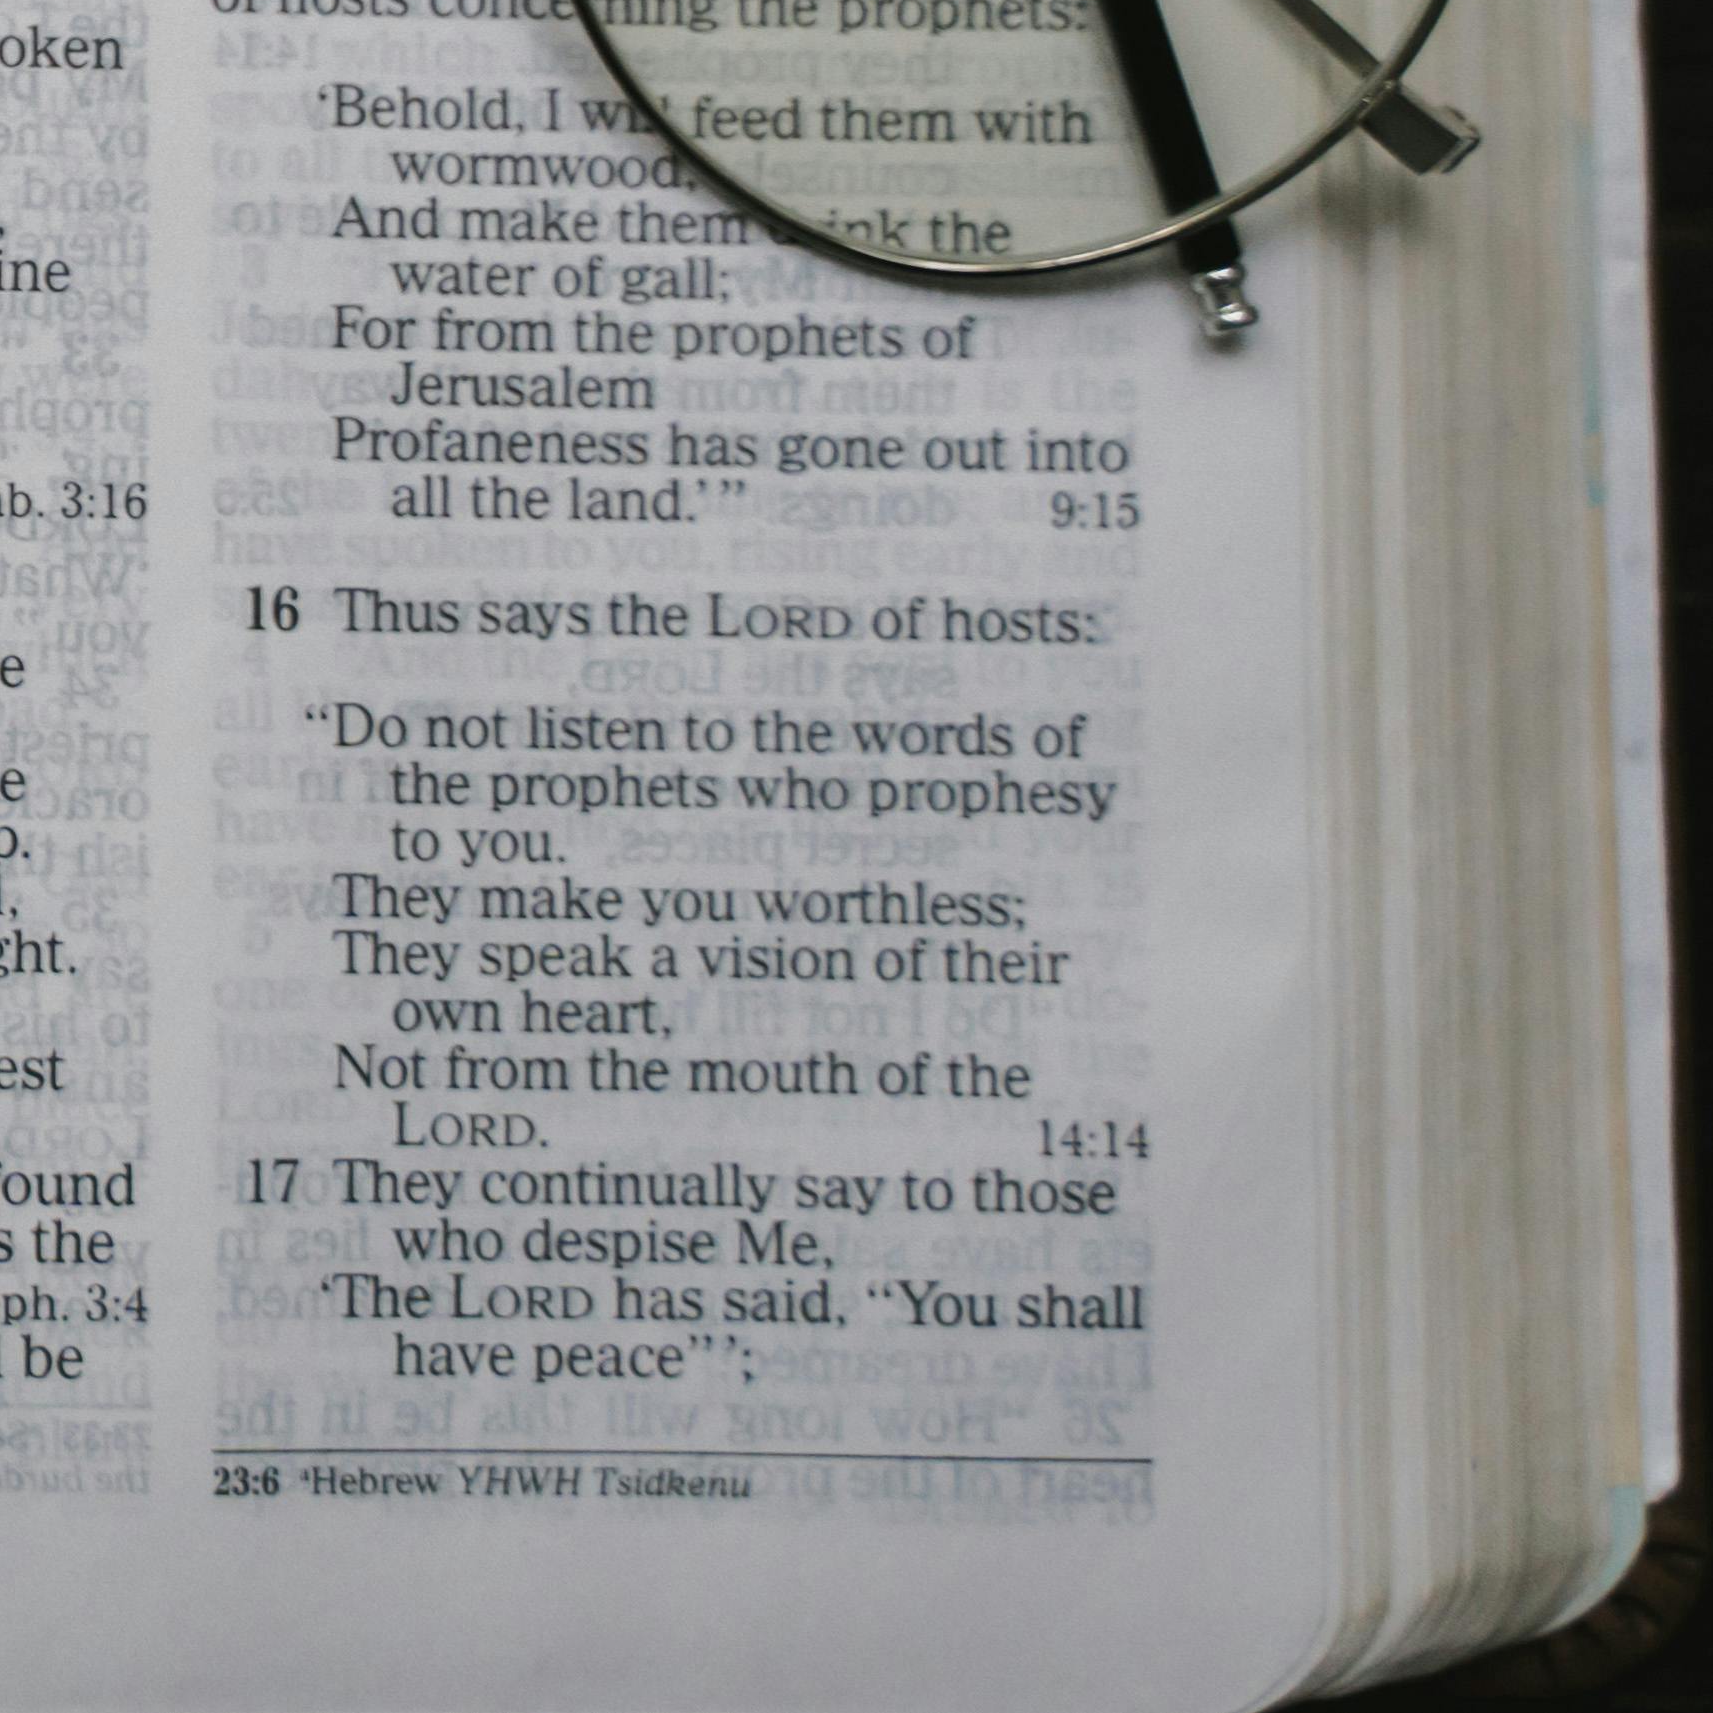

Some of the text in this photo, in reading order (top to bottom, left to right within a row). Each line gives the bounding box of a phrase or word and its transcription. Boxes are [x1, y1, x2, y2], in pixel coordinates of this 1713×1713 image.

[60, 481, 148, 521] 3:16
[1049, 490, 1140, 531] 9:15
[247, 585, 1097, 644] 16 Thus says the LORD of hosts:
[1040, 1119, 1149, 1159] 14:14
[85, 1283, 149, 1324] 3:4
[211, 1464, 283, 1498] 23:6
[457, 1465, 583, 1498] YHWH
[595, 1465, 755, 1501] Tsidkenu
